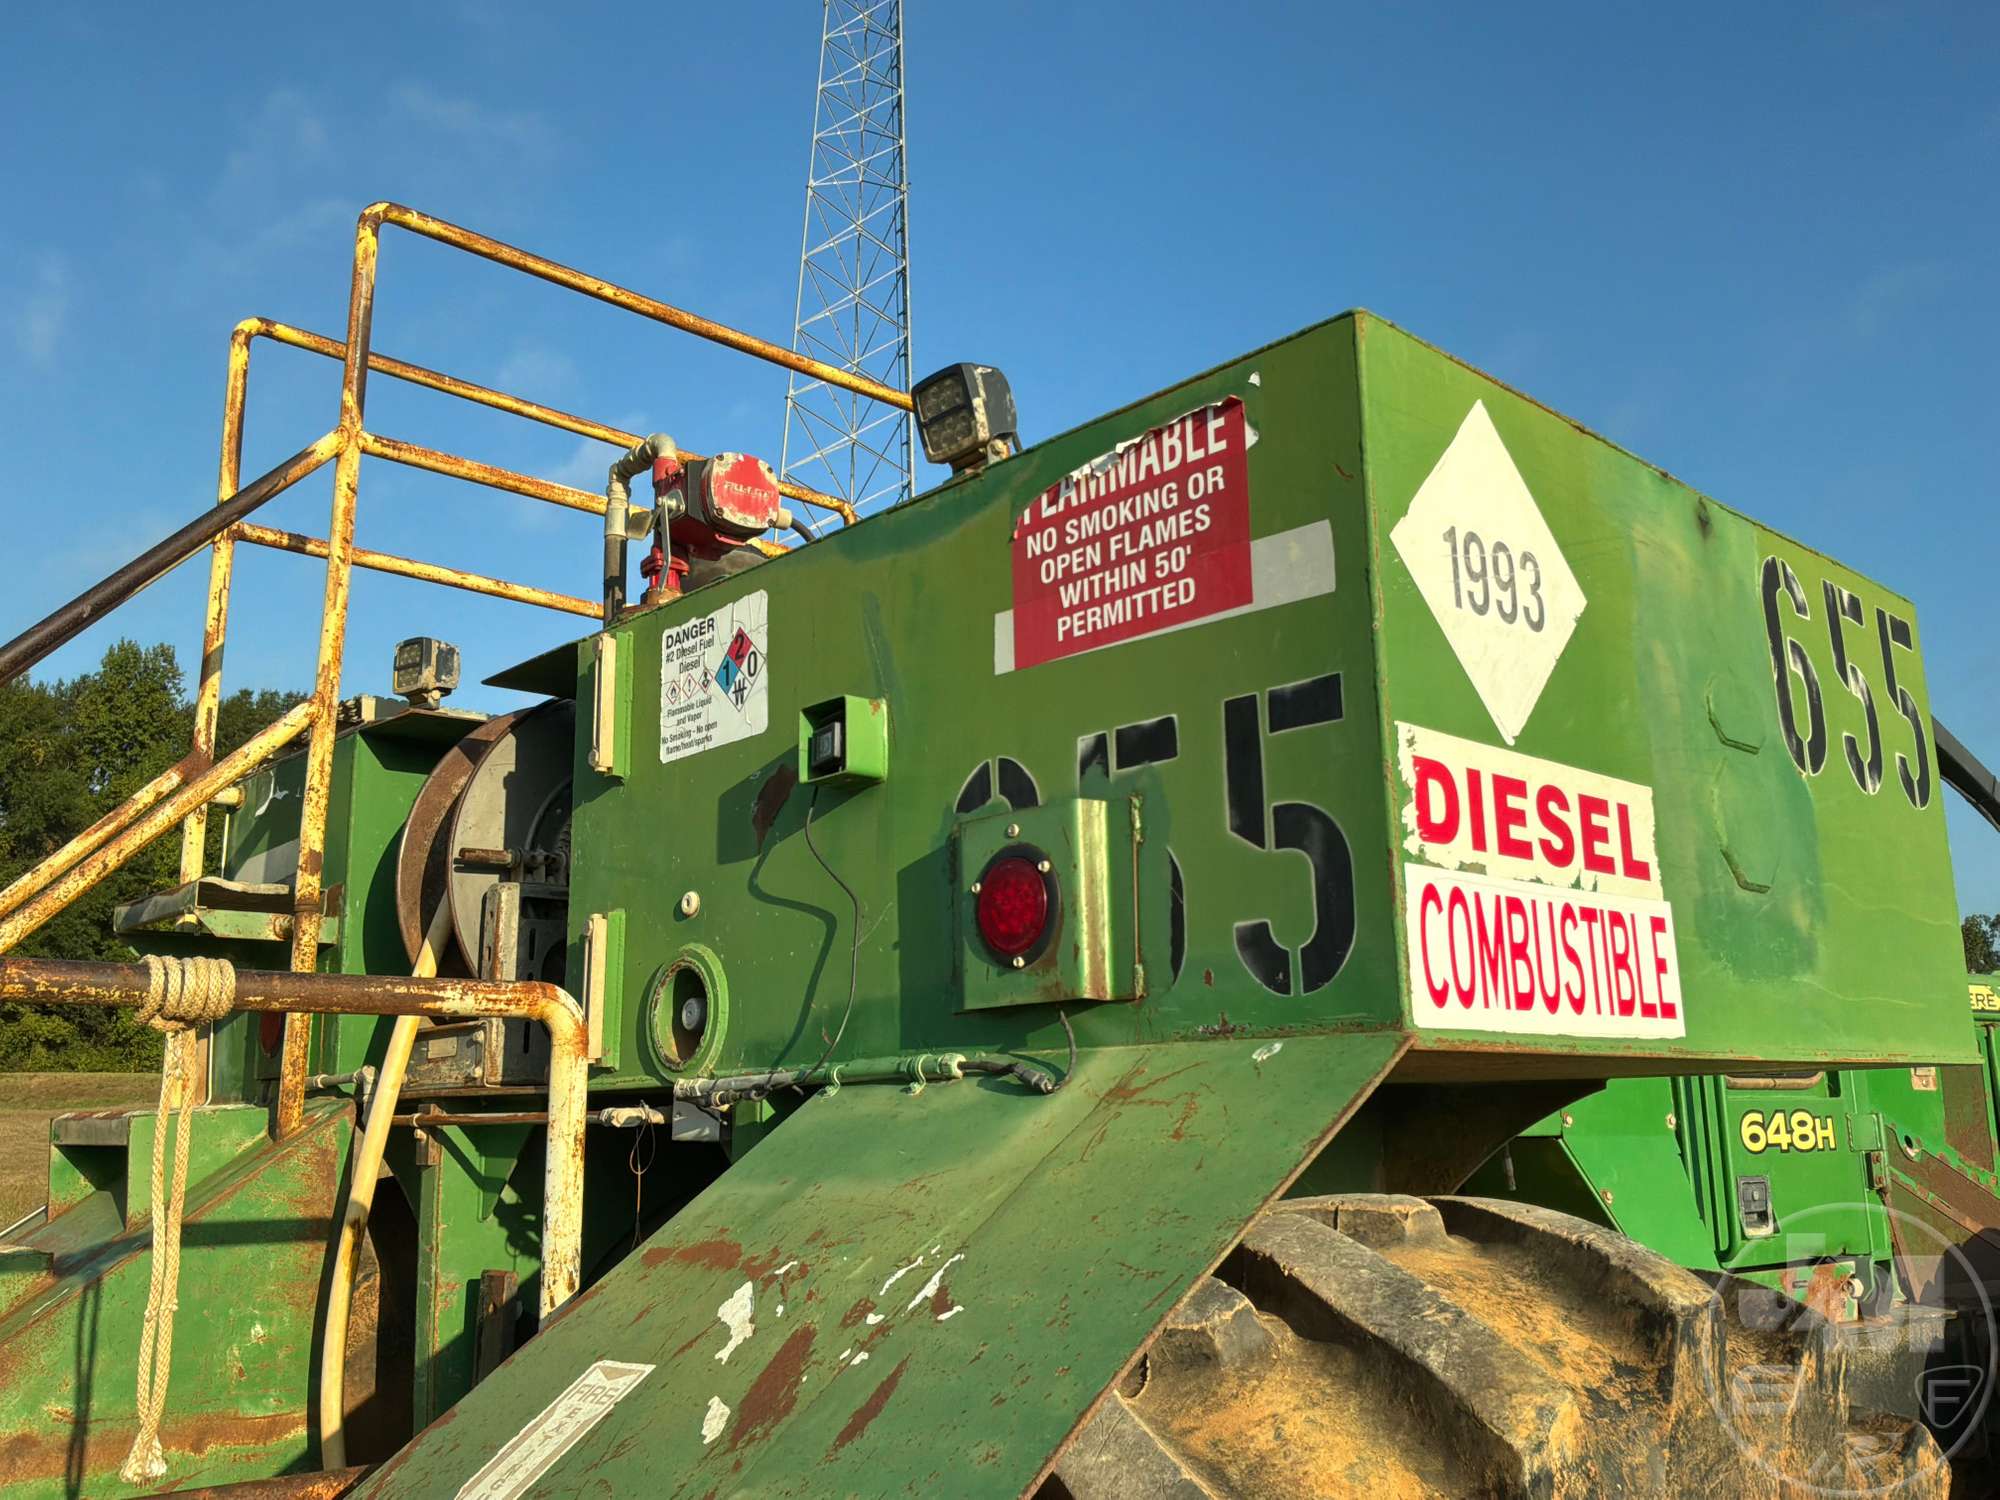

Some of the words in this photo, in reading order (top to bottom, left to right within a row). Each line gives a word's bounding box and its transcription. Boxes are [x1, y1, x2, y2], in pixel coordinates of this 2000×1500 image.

[1026, 527, 1057, 559] NO
[1065, 483, 1178, 545] SMOKING
[1188, 465, 1225, 500] OR
[1040, 542, 1101, 585] OPEN
[1109, 503, 1211, 561] FLAMES
[1059, 559, 1146, 609] WITHIN
[1155, 545, 1192, 578] 50'
[1443, 525, 1545, 632] 1993
[1057, 577, 1196, 642] PERMITTED
[666, 617, 715, 650] DANGER
[666, 651, 674, 664] #2
[676, 641, 697, 660] Diesel
[700, 635, 714, 651] Fuel
[735, 634, 745, 660] 2
[679, 656, 700, 674] Diesel
[723, 660, 730, 686] 1
[747, 651, 757, 677] 0
[1760, 555, 1930, 810] 655
[687, 711, 702, 723] Vapor
[695, 695, 712, 709] Liquid
[670, 730, 692, 743] Smoking
[705, 720, 718, 733] open
[1412, 754, 1652, 883] DIESEL
[1419, 882, 1678, 1020] COMBUSTIBLE
[1740, 1109, 1837, 1154] 648H
[566, 1383, 620, 1405] FIRE
